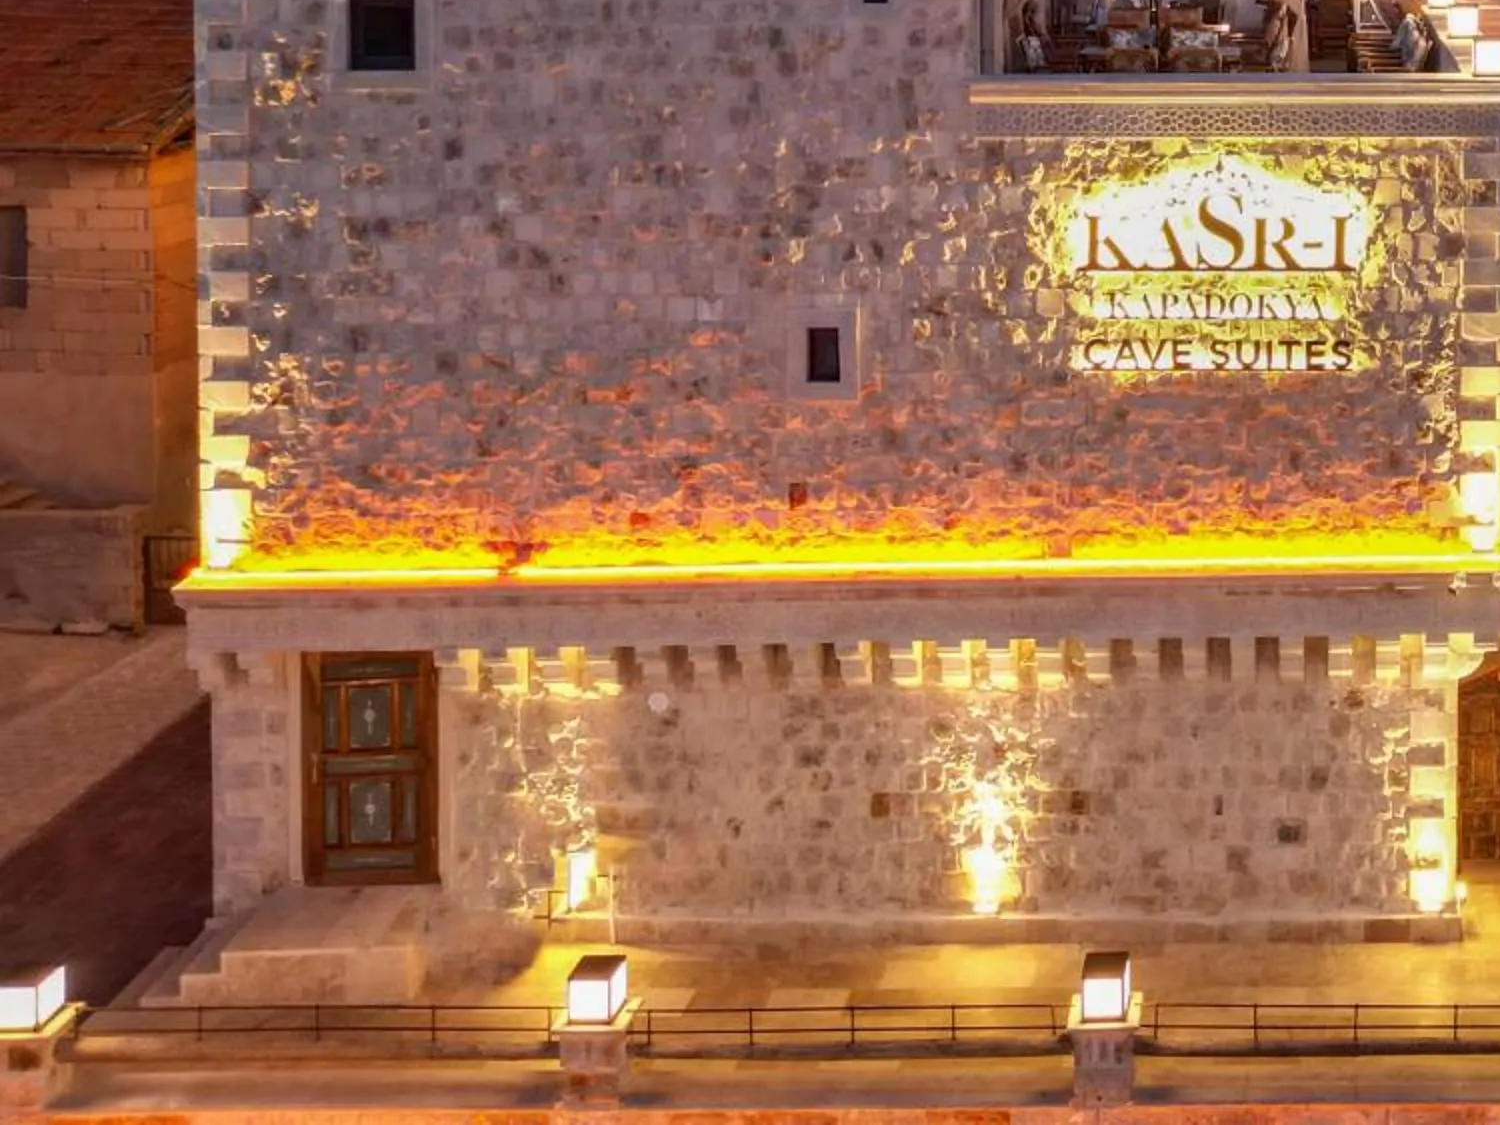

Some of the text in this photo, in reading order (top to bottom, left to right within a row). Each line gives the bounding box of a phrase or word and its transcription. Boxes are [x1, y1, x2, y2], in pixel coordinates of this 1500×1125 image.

[1078, 192, 1355, 271] KASR-I
[1104, 291, 1327, 320] KAPADOKYA
[1083, 339, 1353, 369] CAVE SUITES
